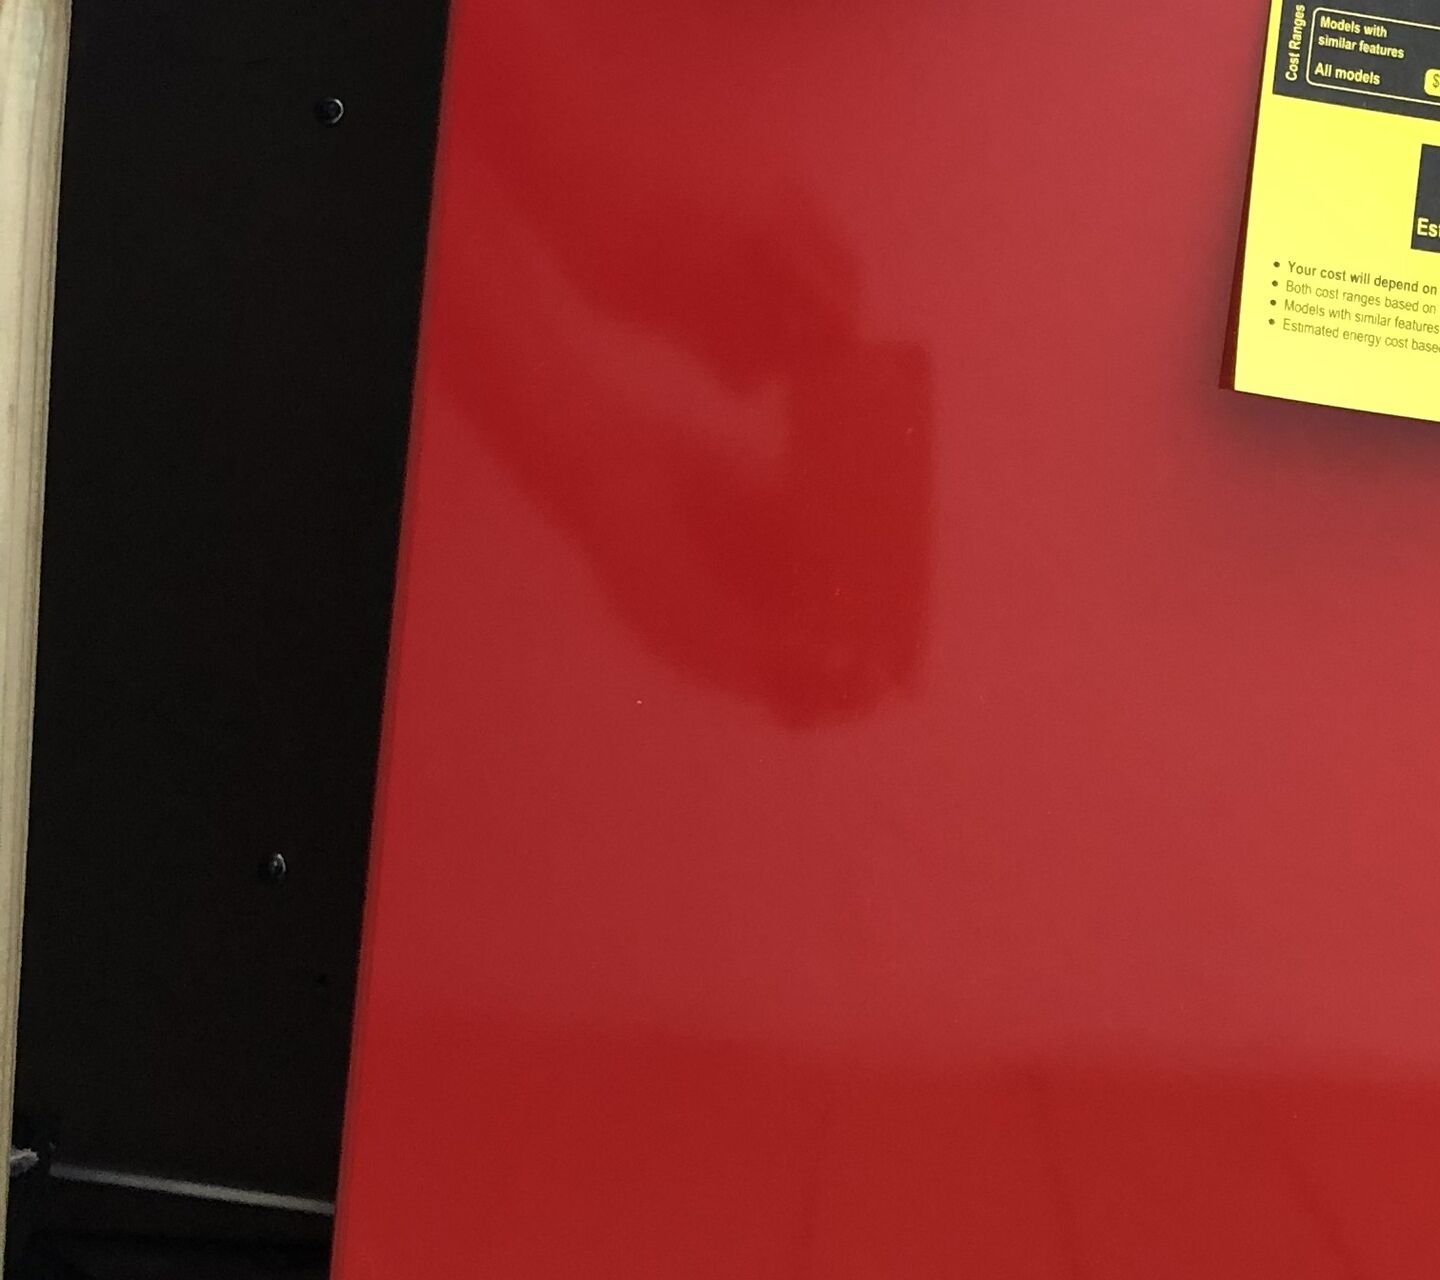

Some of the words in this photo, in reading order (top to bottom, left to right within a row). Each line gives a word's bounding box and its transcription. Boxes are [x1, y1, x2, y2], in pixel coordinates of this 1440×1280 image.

[1289, 4, 1306, 50] Ranges
[1319, 15, 1360, 33] Models
[1363, 24, 1387, 37] with
[1318, 34, 1357, 50] similar
[1358, 39, 1404, 58] features
[1285, 52, 1300, 81] Cost
[1314, 62, 1332, 77] All
[1334, 68, 1380, 84] models
[1288, 260, 1316, 276] Your
[1319, 269, 1346, 281] cost
[1349, 272, 1370, 284] will
[1373, 275, 1418, 292] depend
[1422, 284, 1437, 295] on
[1285, 279, 1311, 294] Both
[1315, 287, 1338, 299] cost
[1342, 291, 1380, 307] ranges
[1384, 296, 1419, 312] based
[1421, 303, 1436, 314] on
[1284, 298, 1325, 316] Models
[1328, 308, 1351, 320] with
[1354, 312, 1391, 326] similar
[1394, 315, 1439, 334] features
[1282, 317, 1339, 338] Estimated
[1342, 330, 1381, 347] energy
[1384, 336, 1408, 348] cost
